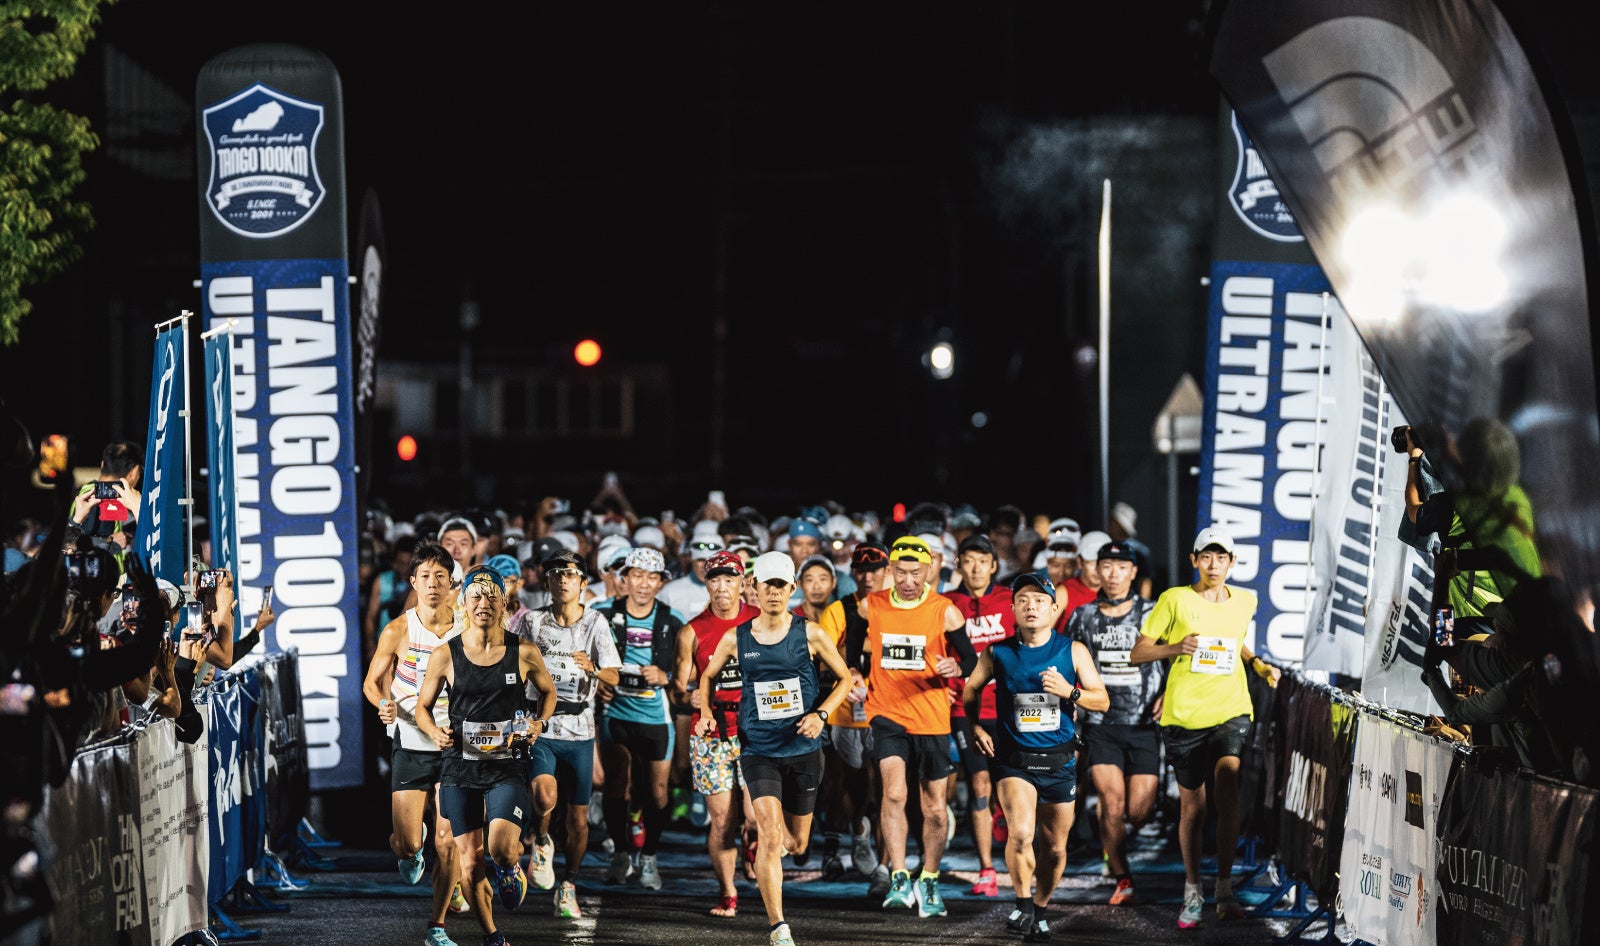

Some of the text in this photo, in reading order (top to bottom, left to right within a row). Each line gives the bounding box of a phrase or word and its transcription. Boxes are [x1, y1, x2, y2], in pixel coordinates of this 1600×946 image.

[265, 275, 347, 770] TANGO 100km
[761, 693, 799, 706] 2044 A
[1020, 708, 1042, 717] 2022
[469, 736, 493, 745] 2007
